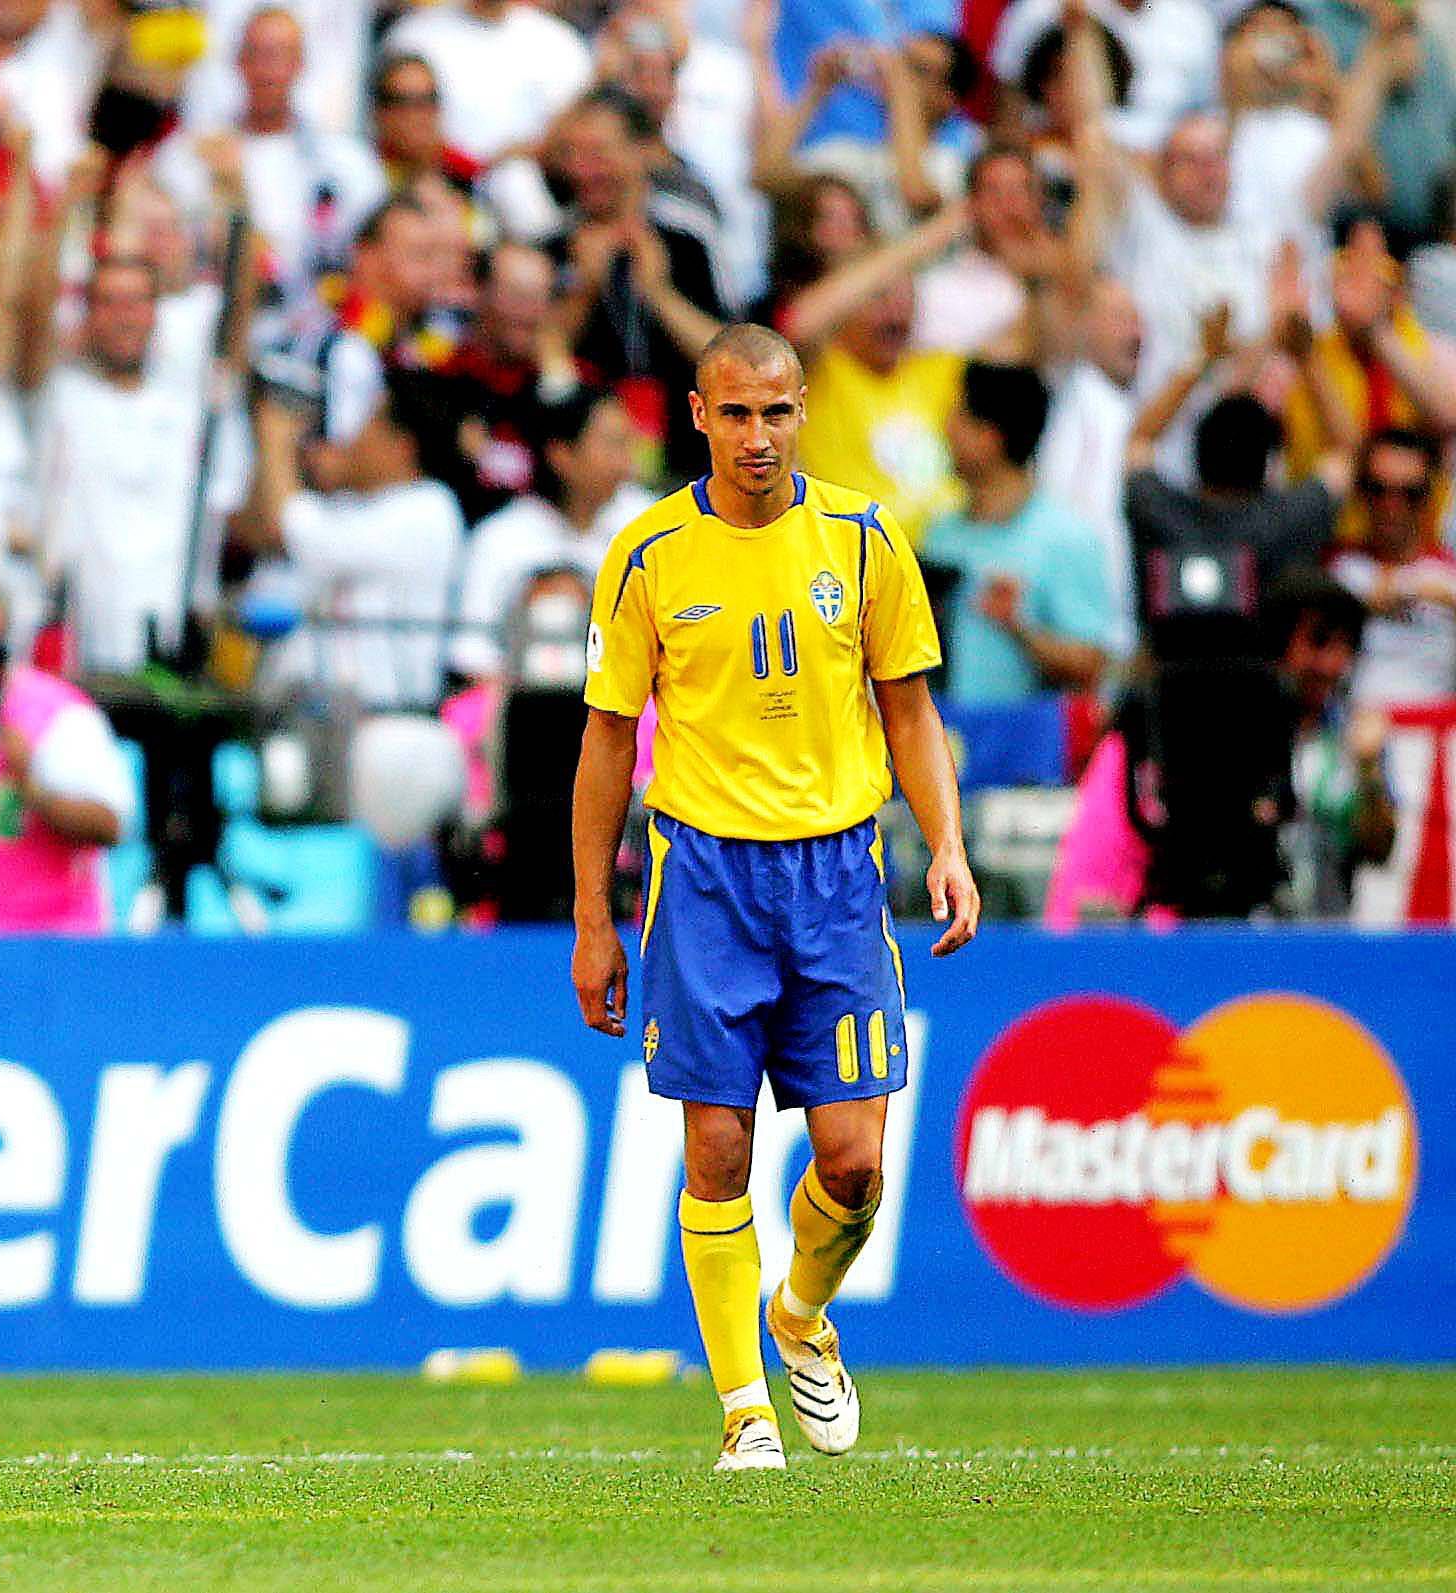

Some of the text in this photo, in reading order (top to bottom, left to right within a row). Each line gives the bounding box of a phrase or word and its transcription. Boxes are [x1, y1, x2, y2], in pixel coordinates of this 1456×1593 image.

[751, 609, 798, 679] 11
[835, 1009, 889, 1083] 11
[964, 1106, 1408, 1204] MasterCard
